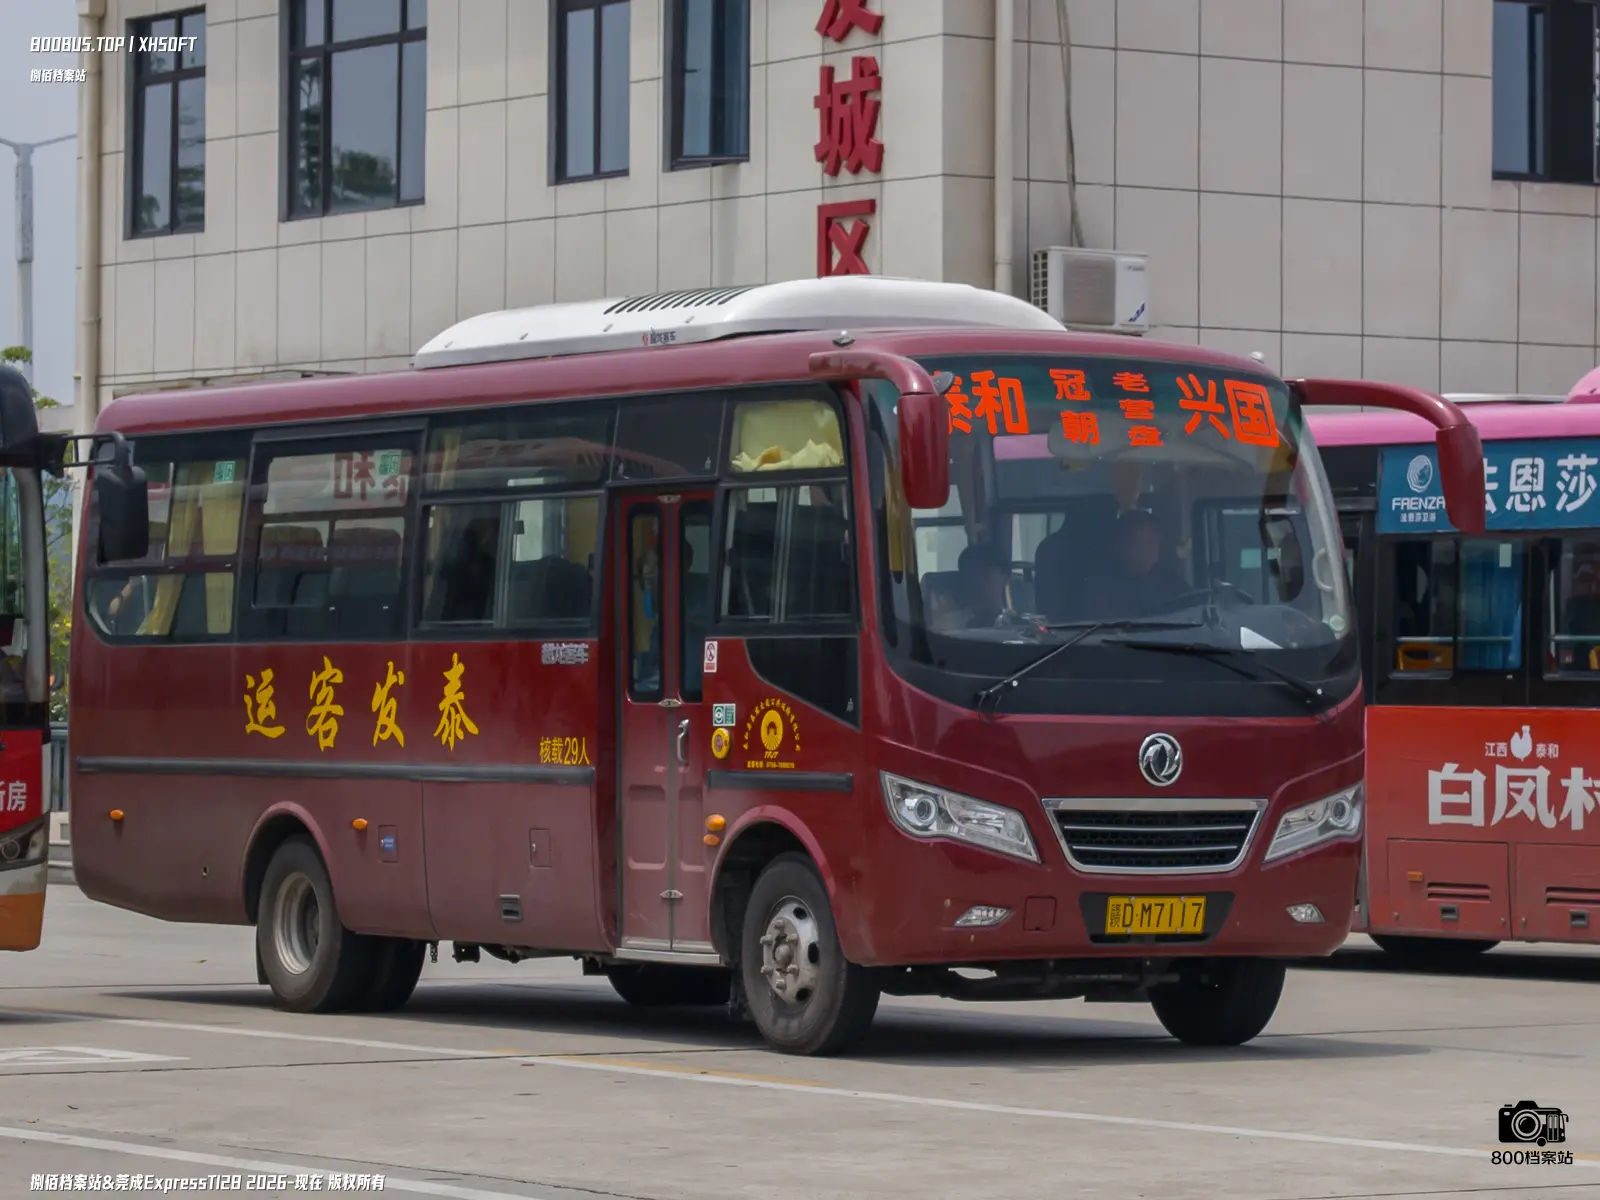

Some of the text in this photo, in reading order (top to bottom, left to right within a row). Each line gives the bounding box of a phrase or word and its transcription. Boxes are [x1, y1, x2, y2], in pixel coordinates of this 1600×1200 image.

[1175, 373, 1280, 448] 兴国
[539, 736, 591, 765] 核载29人
[1485, 742, 1559, 758] 江西 泰和
[0, 780, 27, 812] 房
